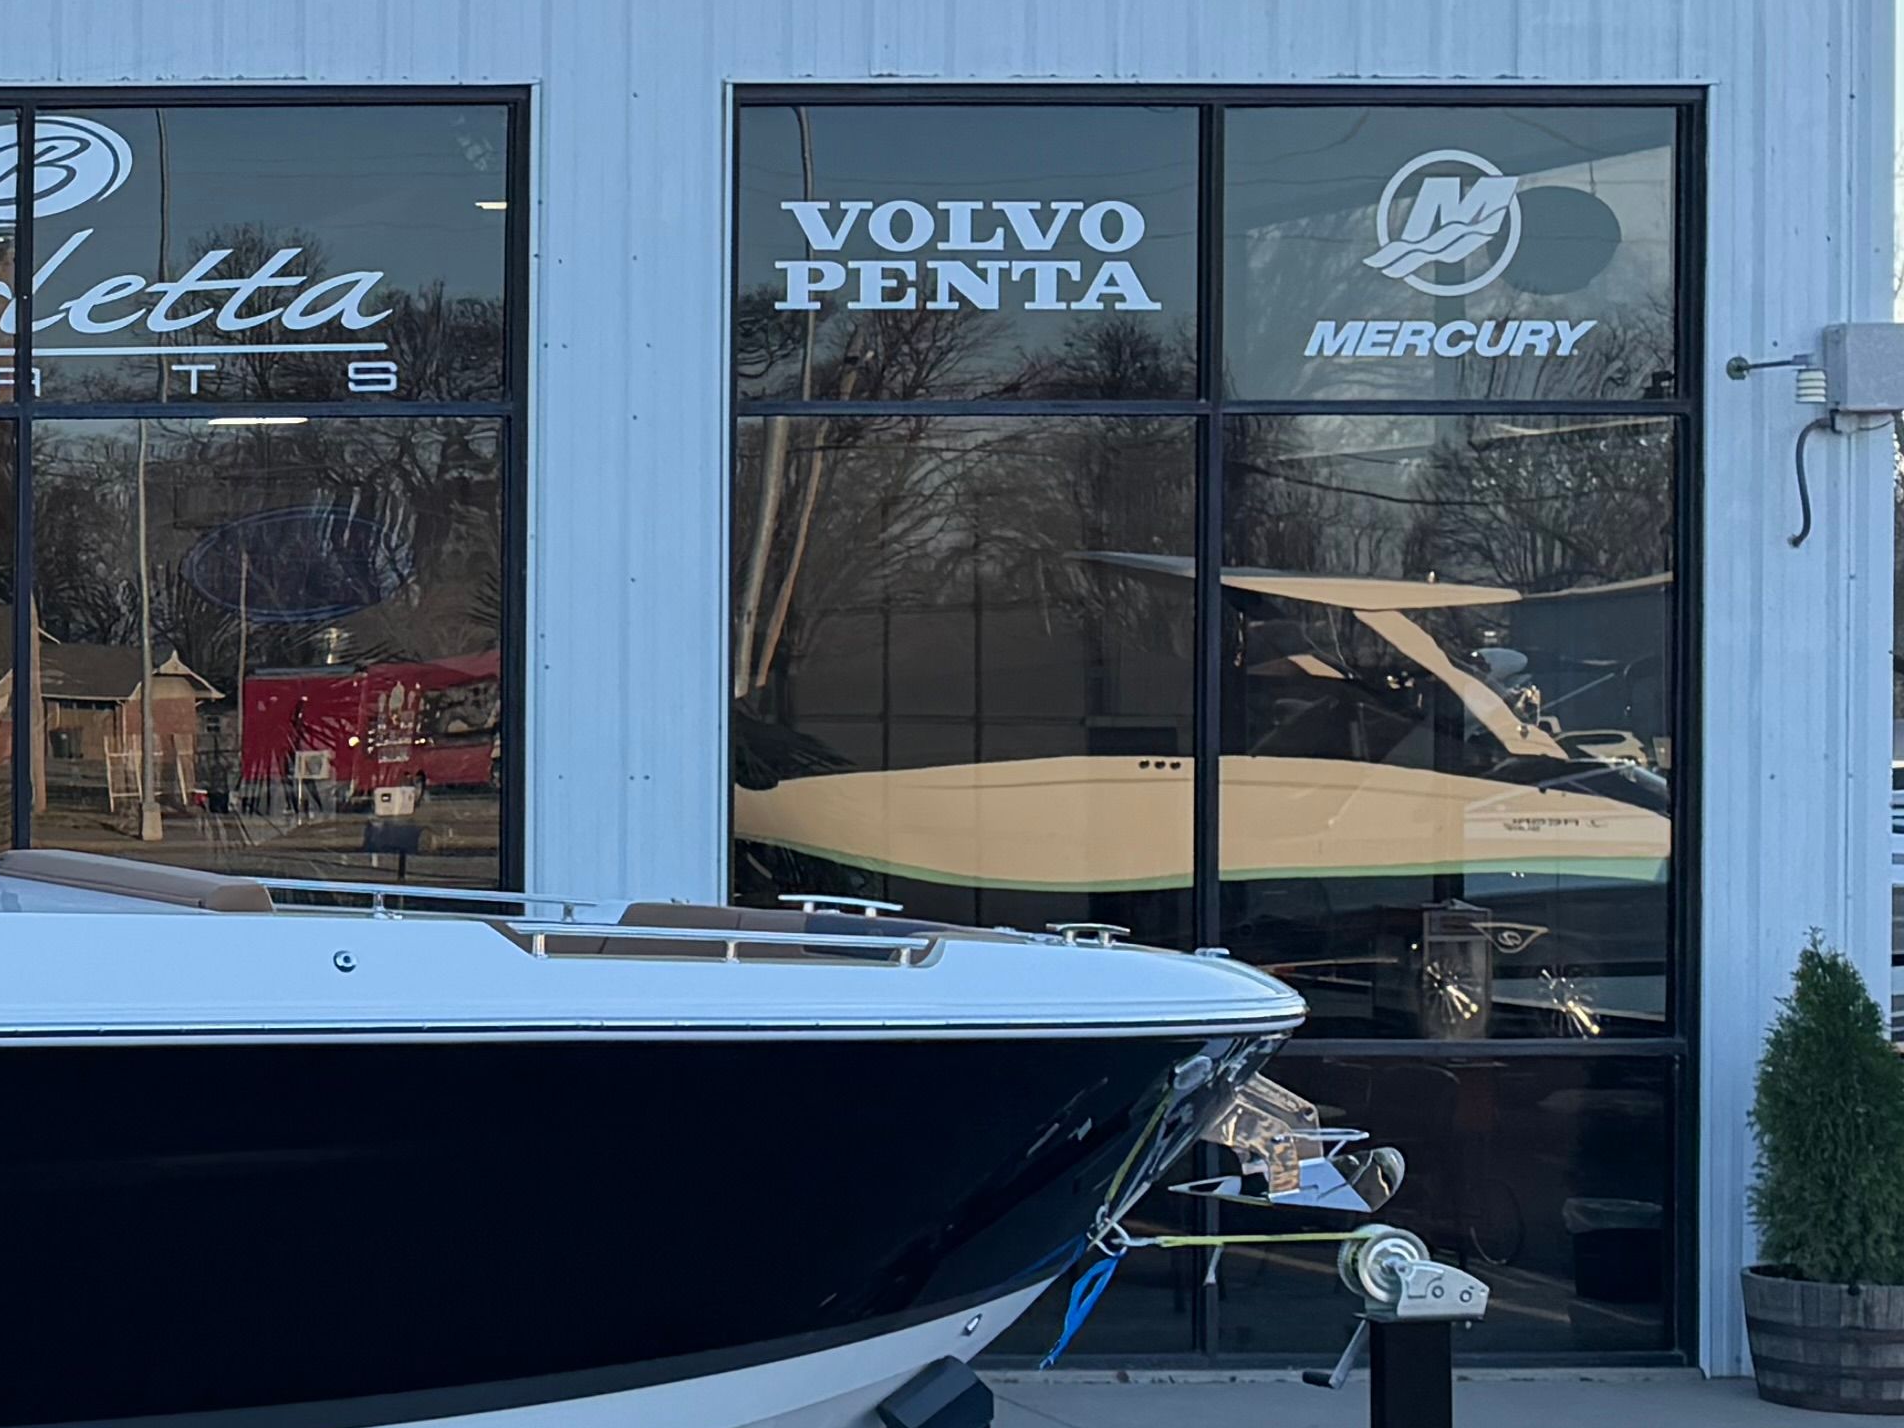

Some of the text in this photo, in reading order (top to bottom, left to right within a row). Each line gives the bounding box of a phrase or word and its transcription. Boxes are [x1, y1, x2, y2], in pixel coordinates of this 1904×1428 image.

[780, 199, 1146, 253] VOLVO
[773, 258, 1164, 312] PENTA
[1304, 319, 1597, 357] MERCURY
